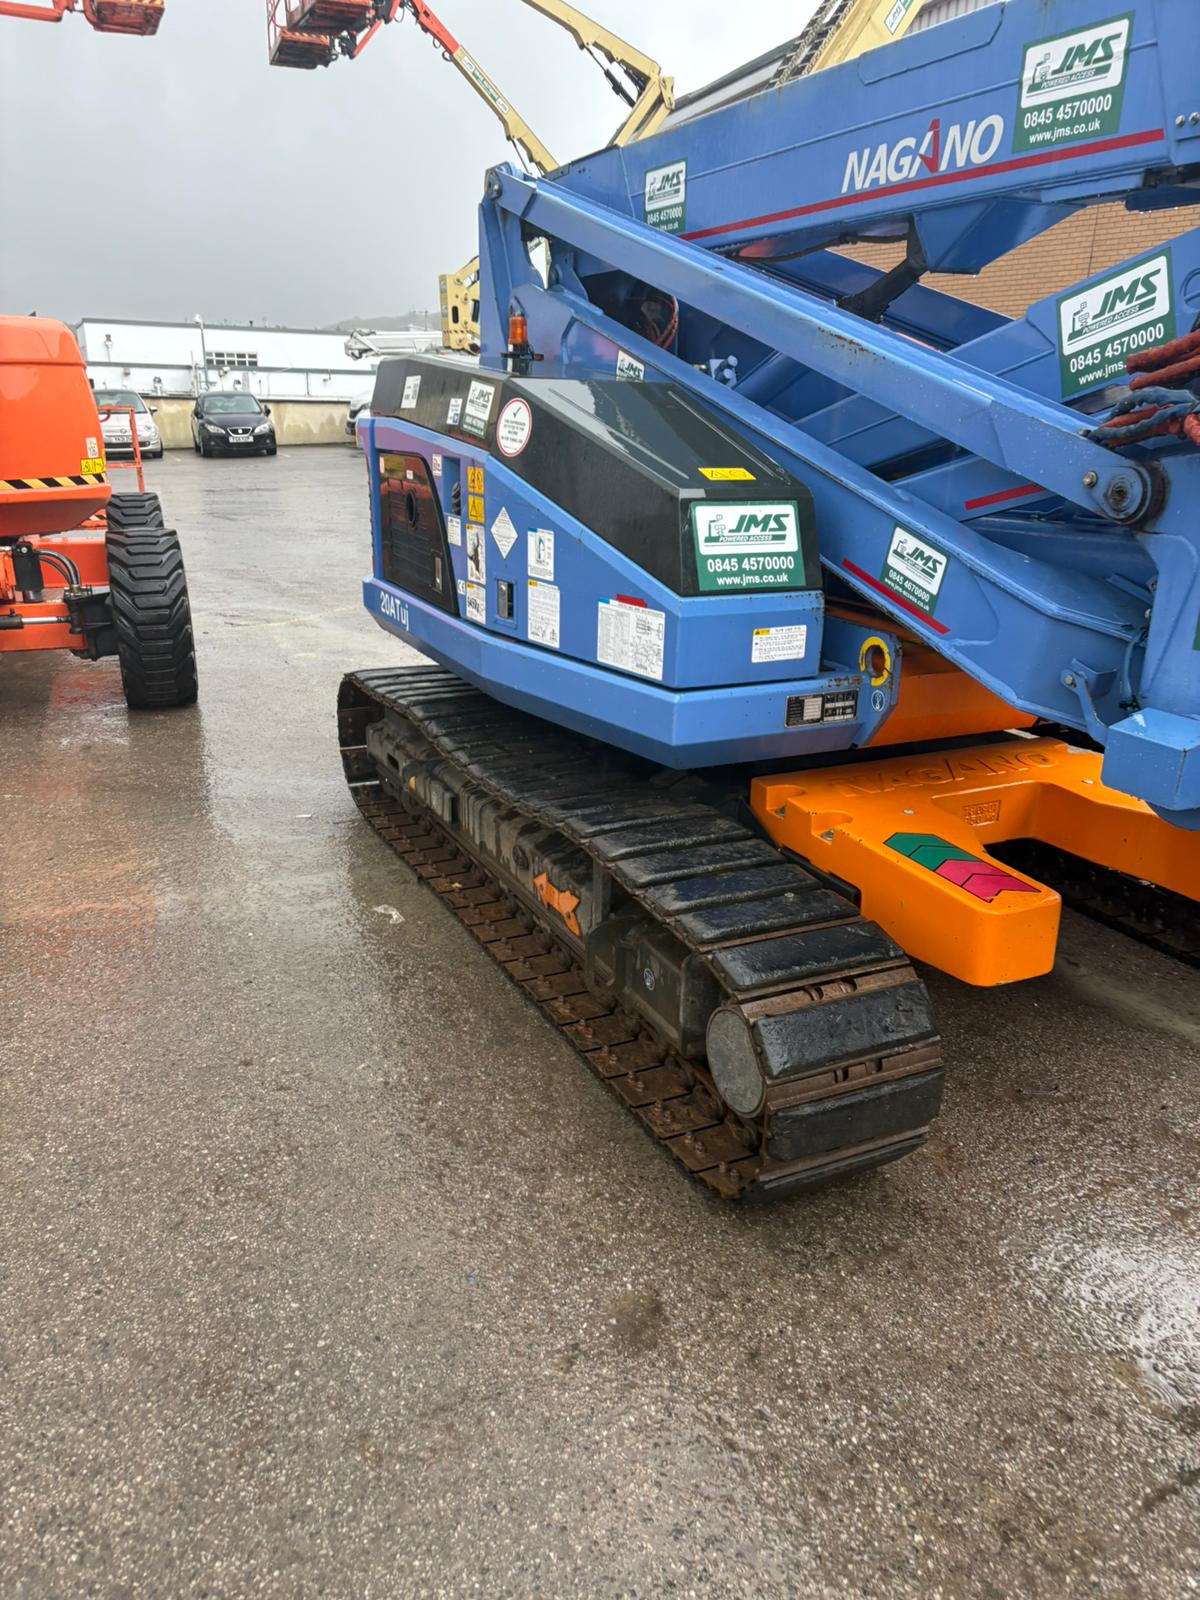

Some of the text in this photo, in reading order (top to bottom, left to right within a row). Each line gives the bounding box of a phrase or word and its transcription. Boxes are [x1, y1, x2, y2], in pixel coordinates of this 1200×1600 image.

[1051, 32, 1122, 76] JMS
[1041, 69, 1096, 89] POWERED ACCESS
[1023, 93, 1112, 129] 0845 4570000
[1029, 118, 1101, 144] www.jms.co.uk
[841, 114, 1004, 194] NAGANO
[657, 169, 683, 192] JMS
[1091, 268, 1161, 321] JMS
[1082, 304, 1140, 334] POWERED ACCESS
[1069, 323, 1165, 373] 0845 4570000
[1078, 361, 1127, 385] www.jms.
[475, 389, 492, 404] JMS
[728, 513, 790, 534] JMS
[719, 534, 773, 543] POWERED ACCESS
[707, 556, 795, 573] 0845 4570000
[906, 547, 943, 574] JMS
[716, 573, 789, 586] www.jms.co.uk
[888, 569, 905, 585] 0845
[380, 591, 410, 632] 20ATuj
